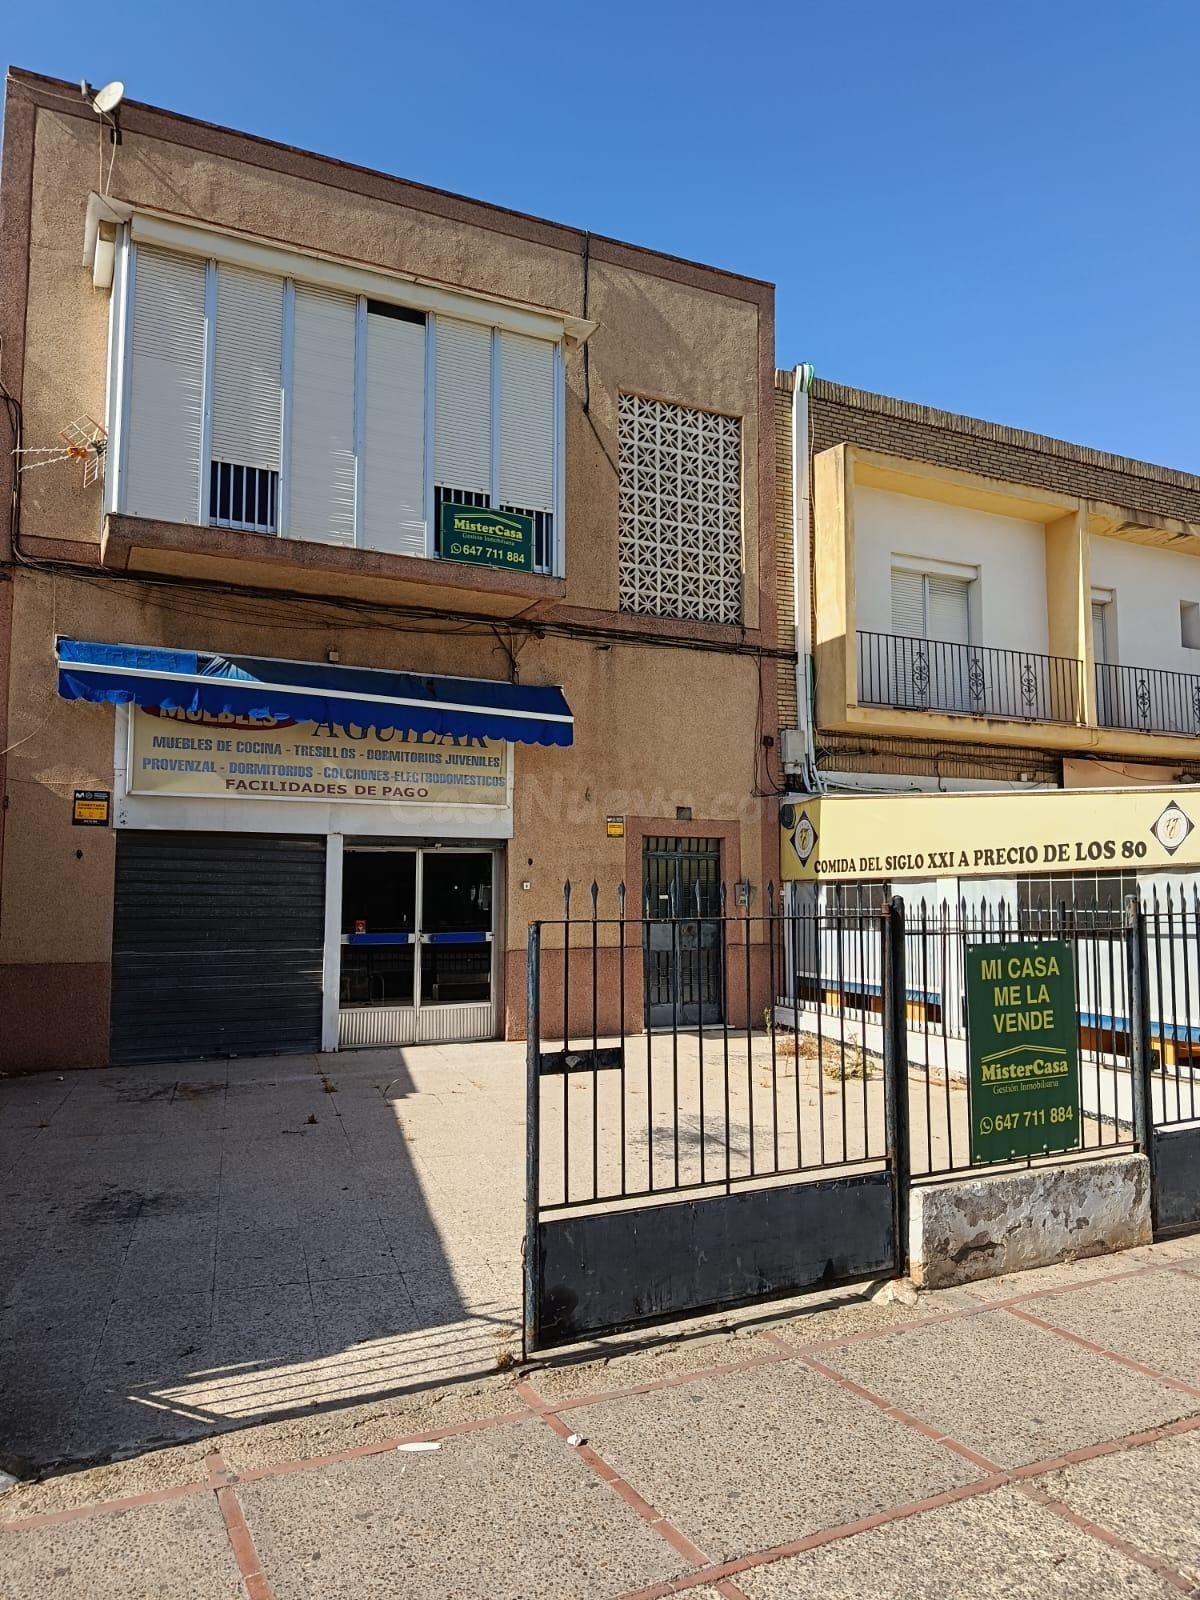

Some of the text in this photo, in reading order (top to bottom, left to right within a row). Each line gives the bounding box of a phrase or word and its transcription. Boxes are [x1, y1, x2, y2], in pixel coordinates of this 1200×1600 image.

[454, 518, 523, 539] MisterCasa
[462, 544, 525, 564] 647 711 884
[152, 736, 213, 751] MUEBLES
[217, 740, 232, 753] DE
[236, 741, 282, 755] COCINA
[367, 749, 442, 764] DORMITORIOS
[445, 754, 500, 768] JUVENILES
[142, 757, 216, 773] PROVENZAL
[229, 762, 313, 778] DORMITORIOS
[225, 779, 429, 798] FACILIDADES DE PAGO
[814, 840, 1147, 874] COMIDA DEL SIGLO XXI A PRECIO DE LOS 80
[981, 956, 1060, 980] MI CASA
[994, 984, 1050, 1007] ME LA
[993, 1009, 1054, 1034] VENDE
[981, 1059, 1068, 1081] MisterCasa
[993, 1080, 1059, 1095] Gestión Inmobiliaria
[995, 1105, 1073, 1131] 647 711 884
